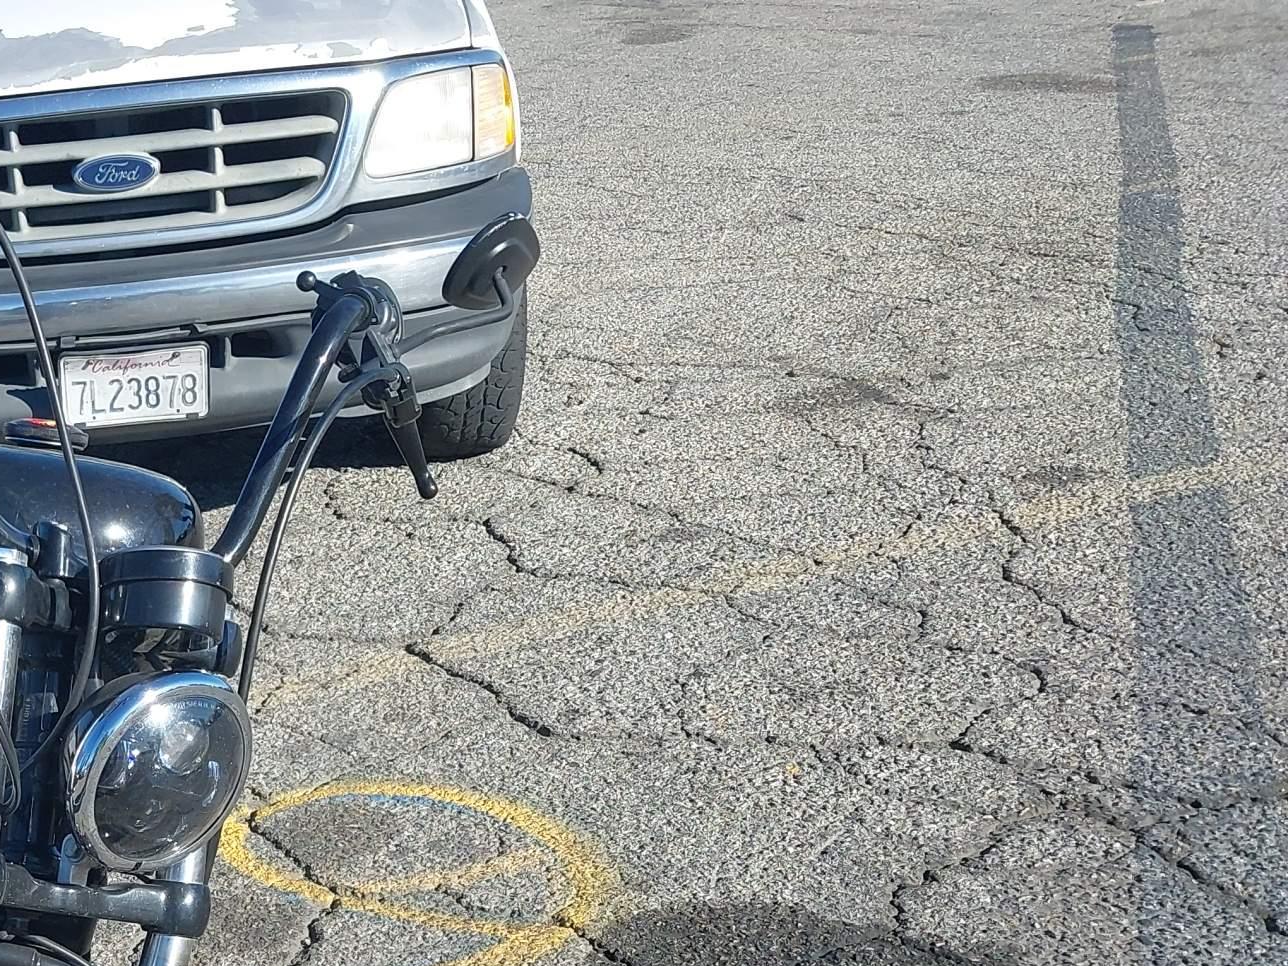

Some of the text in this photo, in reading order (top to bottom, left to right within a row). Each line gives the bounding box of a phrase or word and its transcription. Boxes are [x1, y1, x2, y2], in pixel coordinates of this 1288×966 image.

[95, 161, 140, 183] Ford
[82, 352, 180, 375] California
[71, 373, 198, 416] 7L23878
